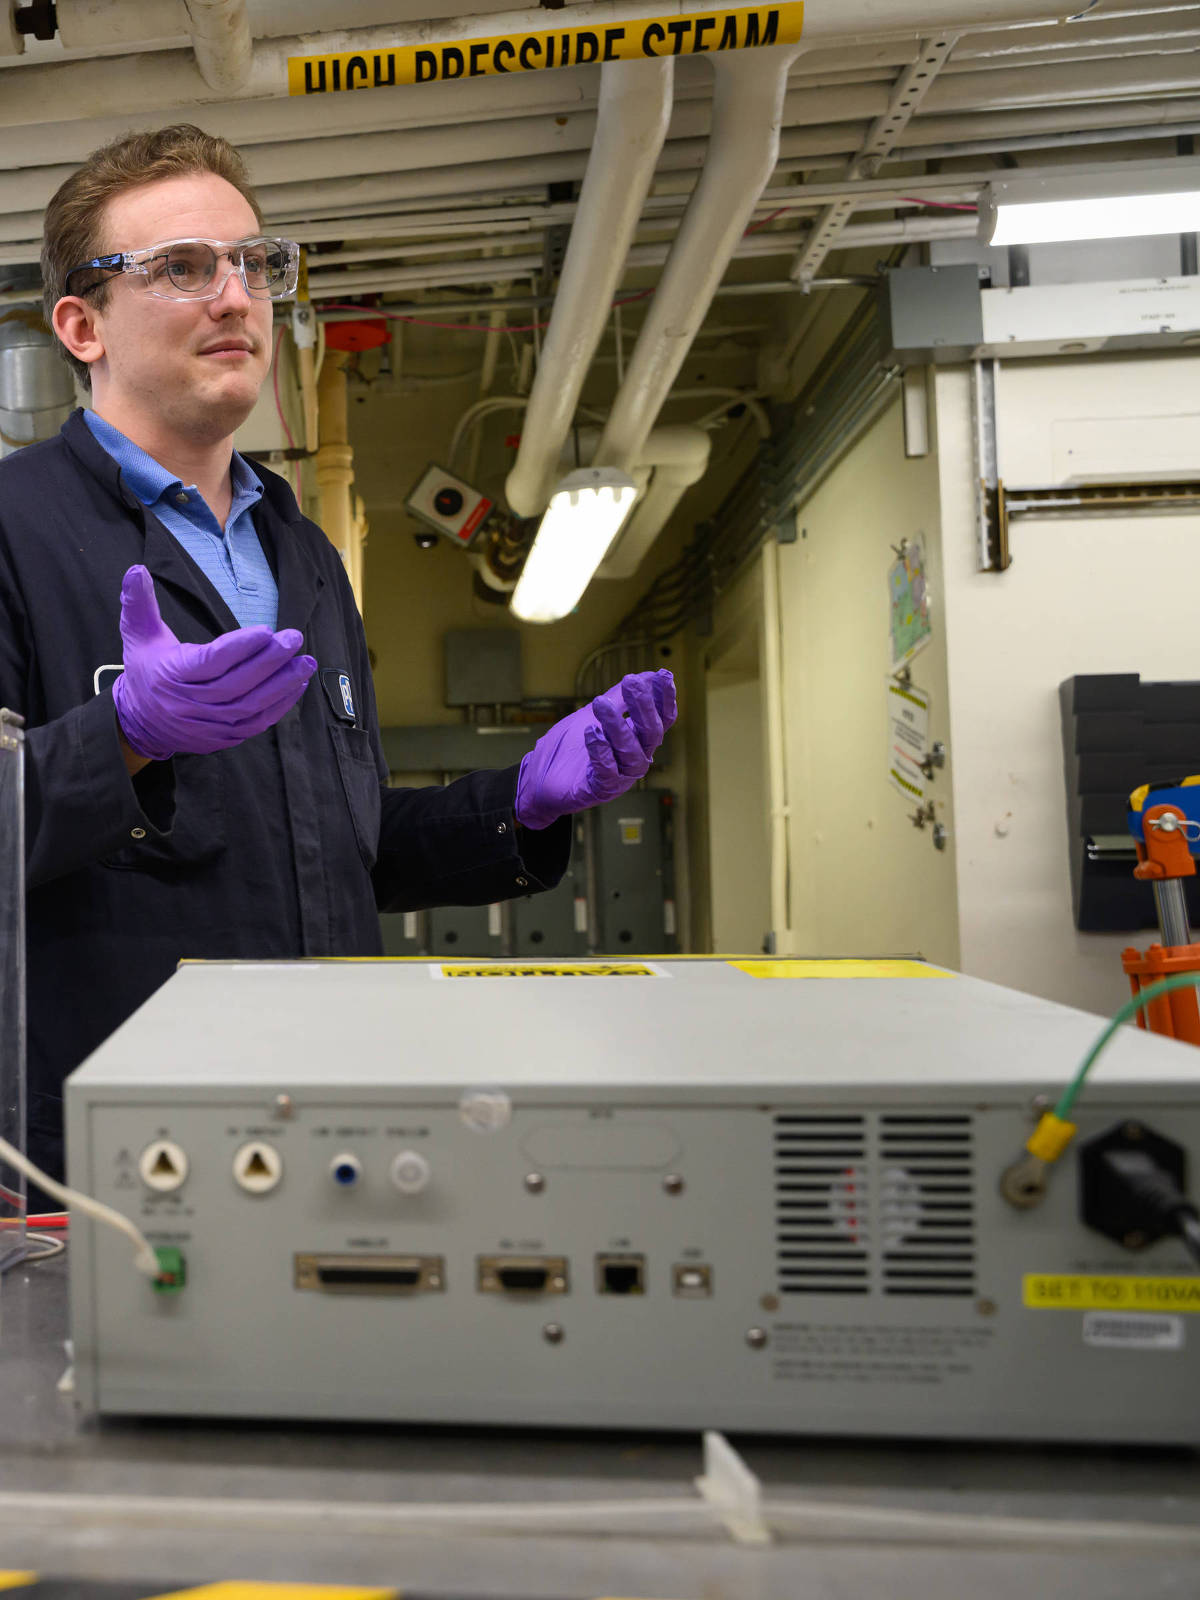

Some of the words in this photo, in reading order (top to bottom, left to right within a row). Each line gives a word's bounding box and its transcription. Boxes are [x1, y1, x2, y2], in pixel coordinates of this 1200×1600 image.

[304, 54, 395, 95] HIGH
[414, 28, 625, 83] PRESSURE
[642, 10, 779, 57] STEAM
[1031, 1278, 1082, 1299] SET
[1089, 1280, 1122, 1302] TO
